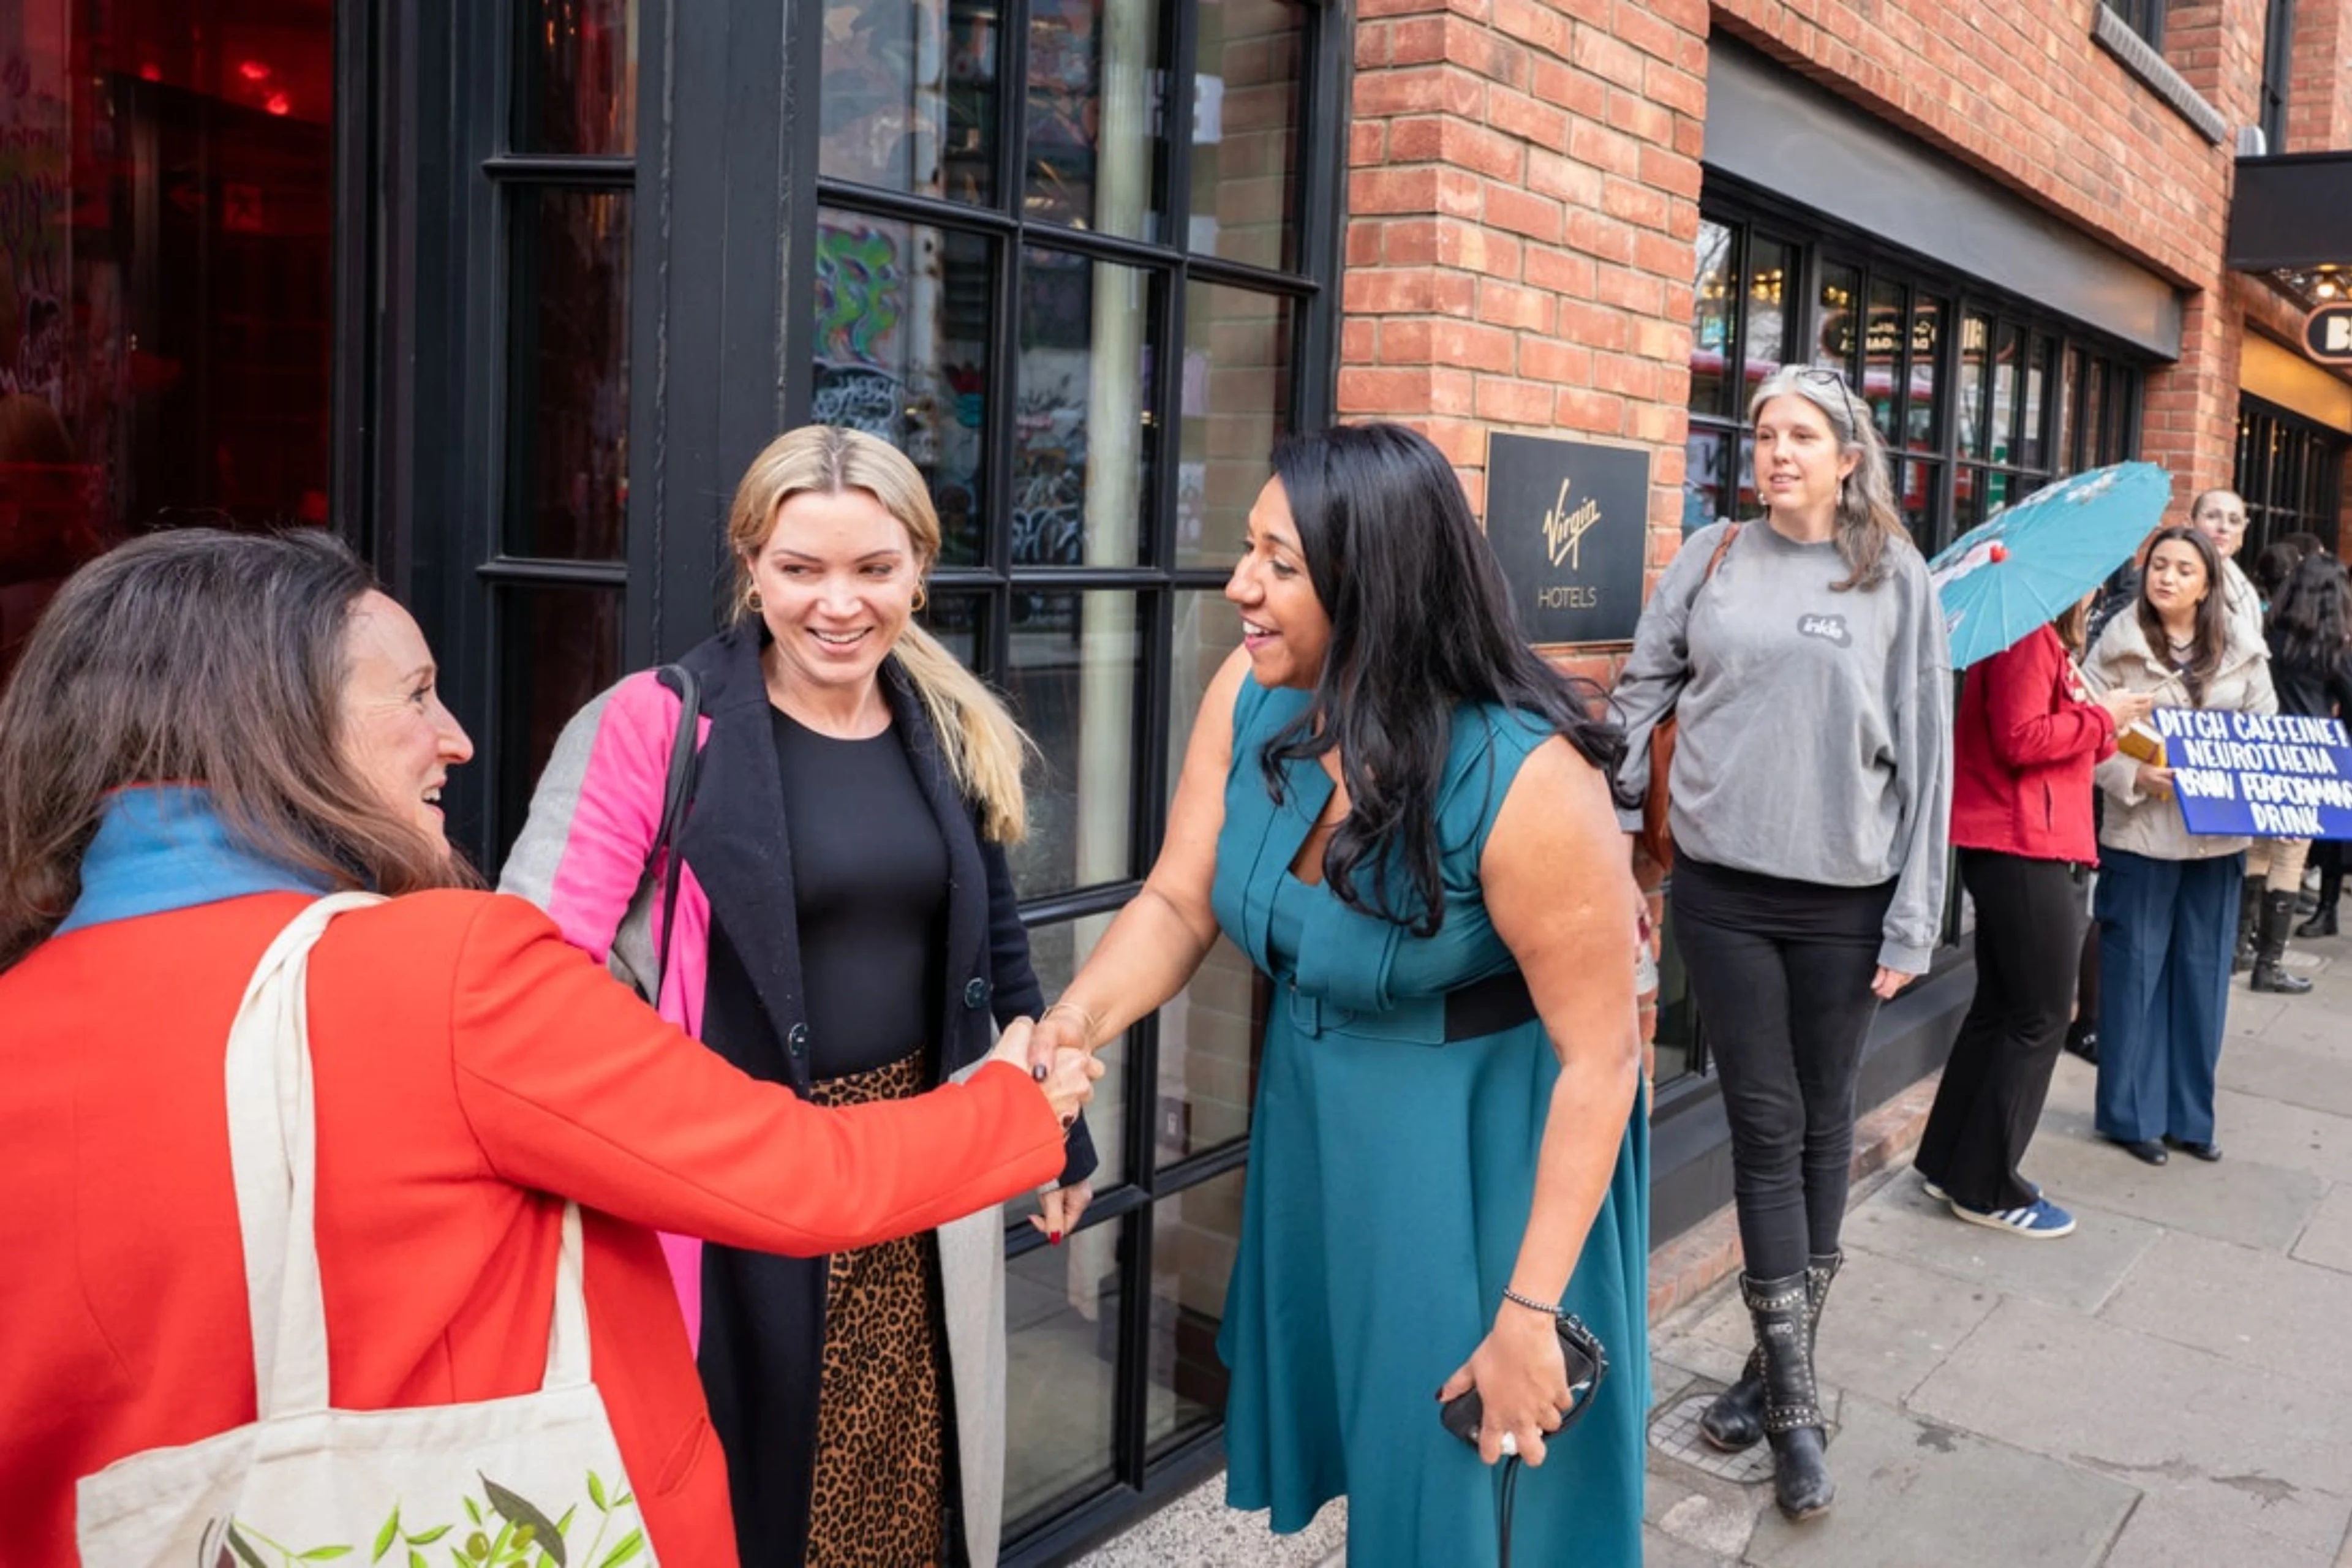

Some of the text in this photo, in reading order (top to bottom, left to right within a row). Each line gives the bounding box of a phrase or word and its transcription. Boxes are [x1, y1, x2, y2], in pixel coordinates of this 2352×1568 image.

[1542, 477, 1601, 571] Virgin
[1538, 586, 1597, 608] HOTELS
[2156, 707, 2229, 739] DITCH
[2183, 739, 2337, 775] NEUROTHENA
[2175, 767, 2235, 801] BRAIN
[2250, 801, 2325, 835] DRINK
